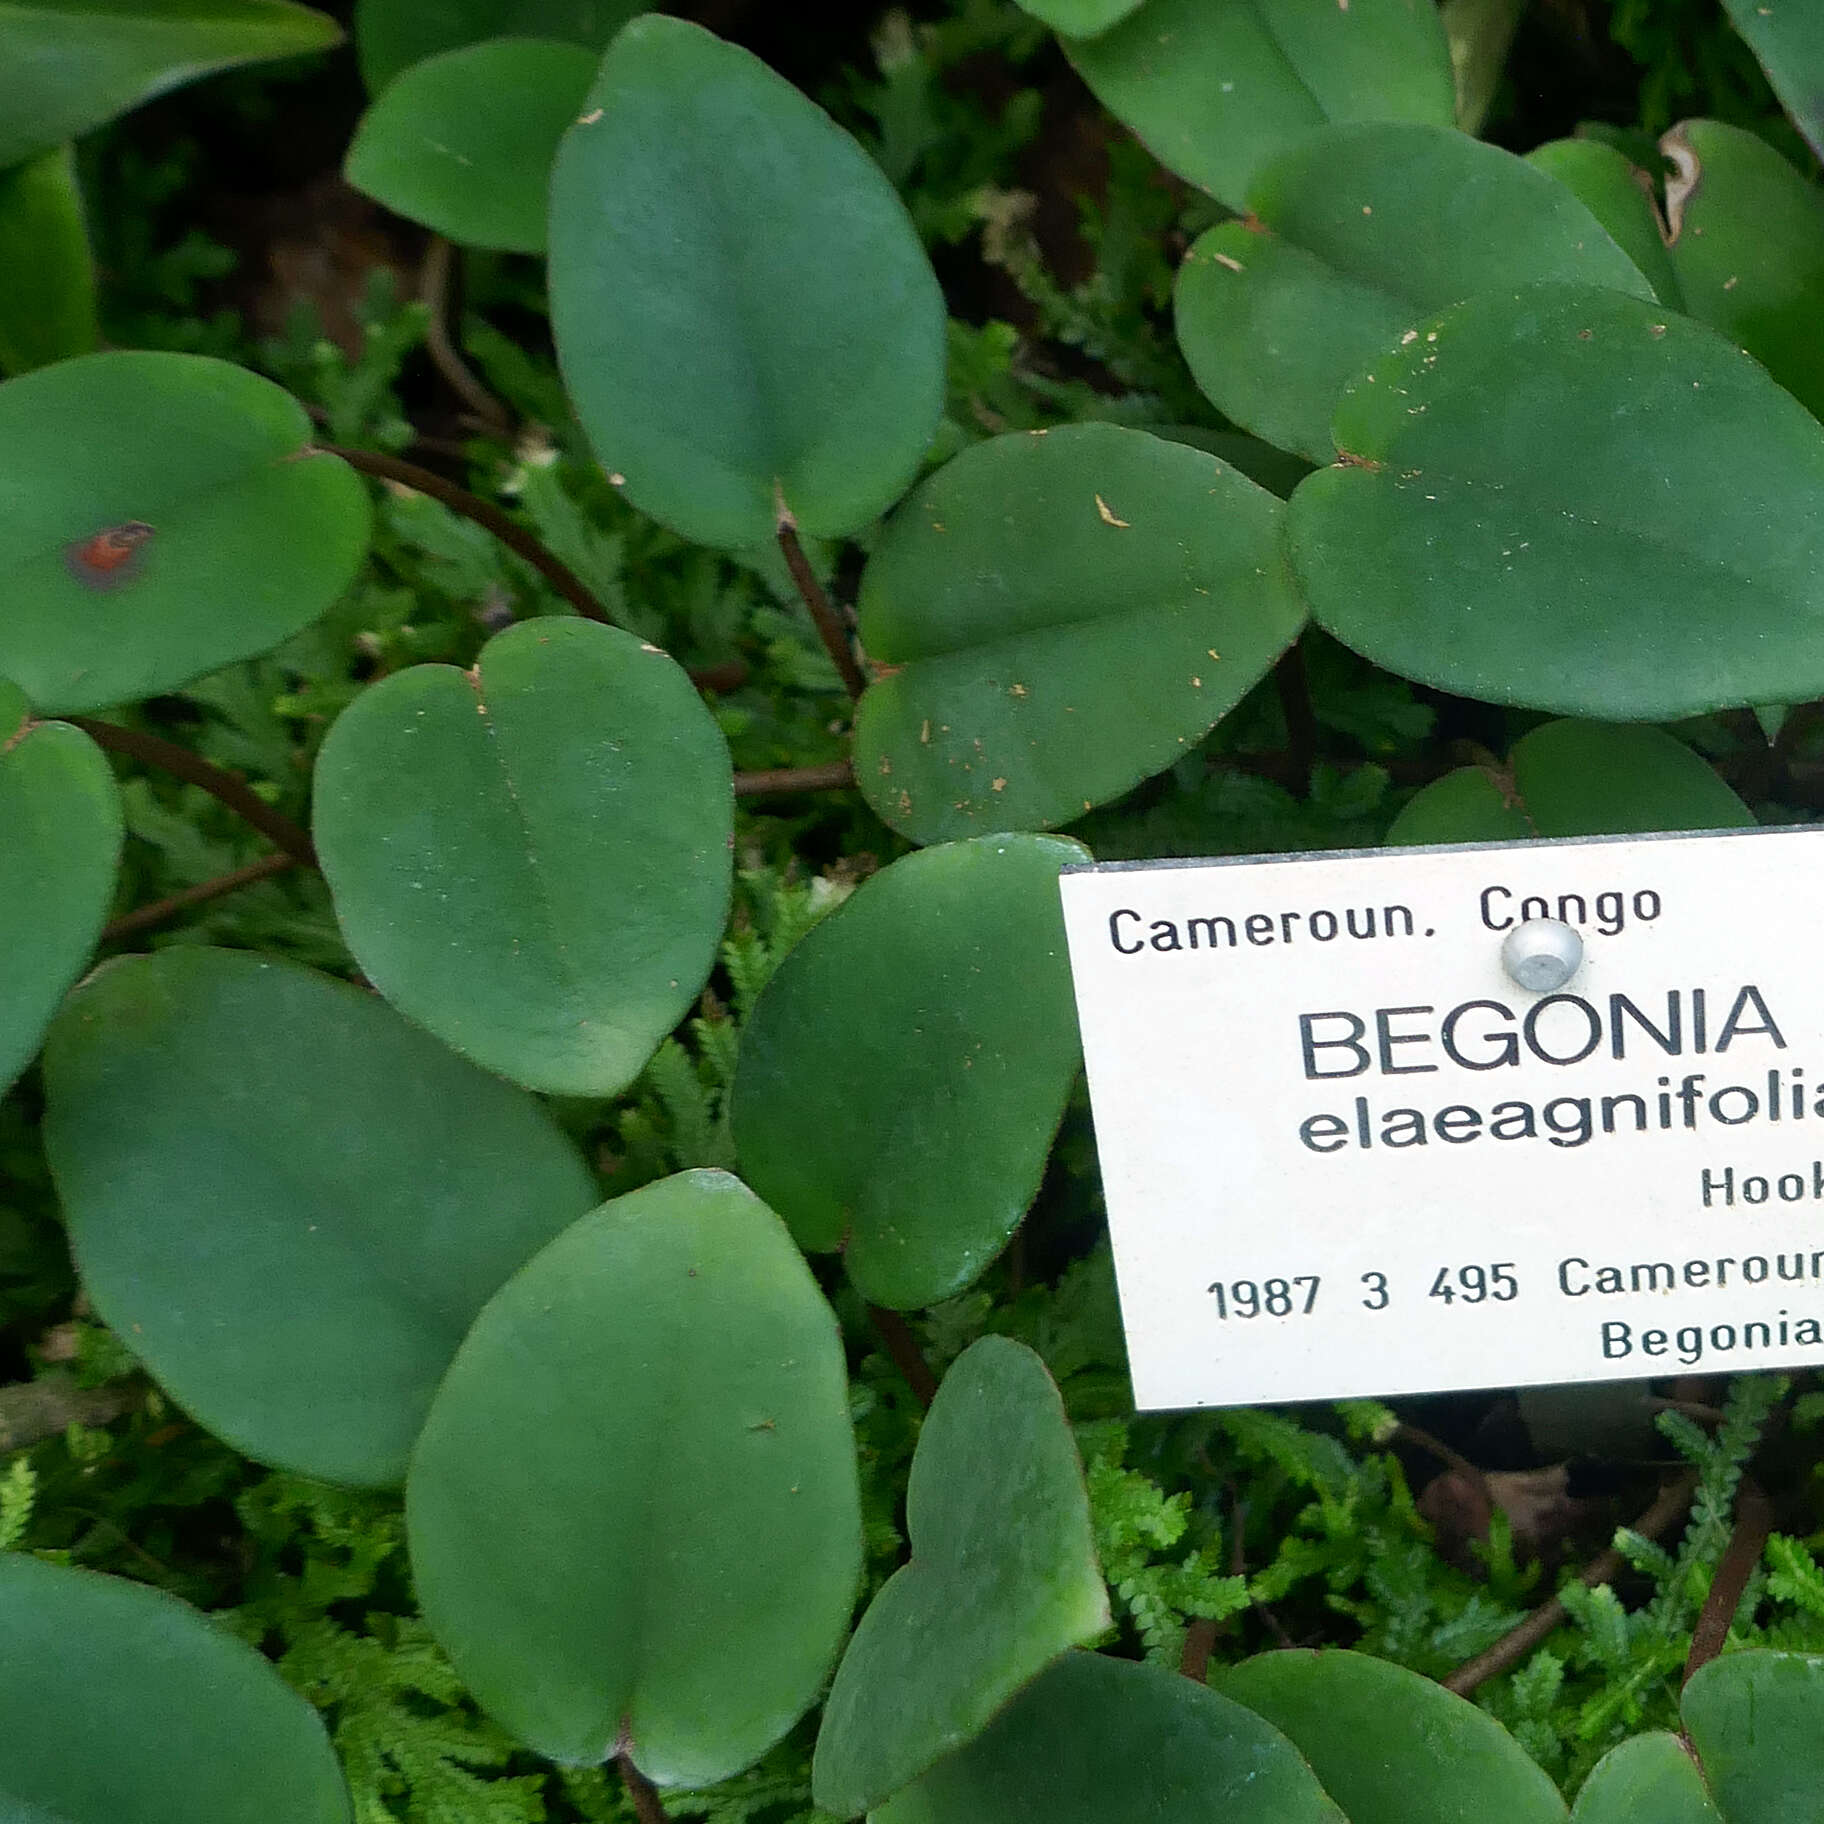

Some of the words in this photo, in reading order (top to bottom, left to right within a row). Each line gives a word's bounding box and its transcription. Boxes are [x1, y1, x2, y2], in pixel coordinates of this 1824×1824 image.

[1108, 902, 1436, 956] Cameroun.
[1479, 884, 1662, 937] Congo
[1299, 984, 1788, 1081] BEGONIA
[1205, 1271, 1323, 1322] 1987
[1360, 1271, 1390, 1312] 3
[1427, 1261, 1519, 1306] 495
